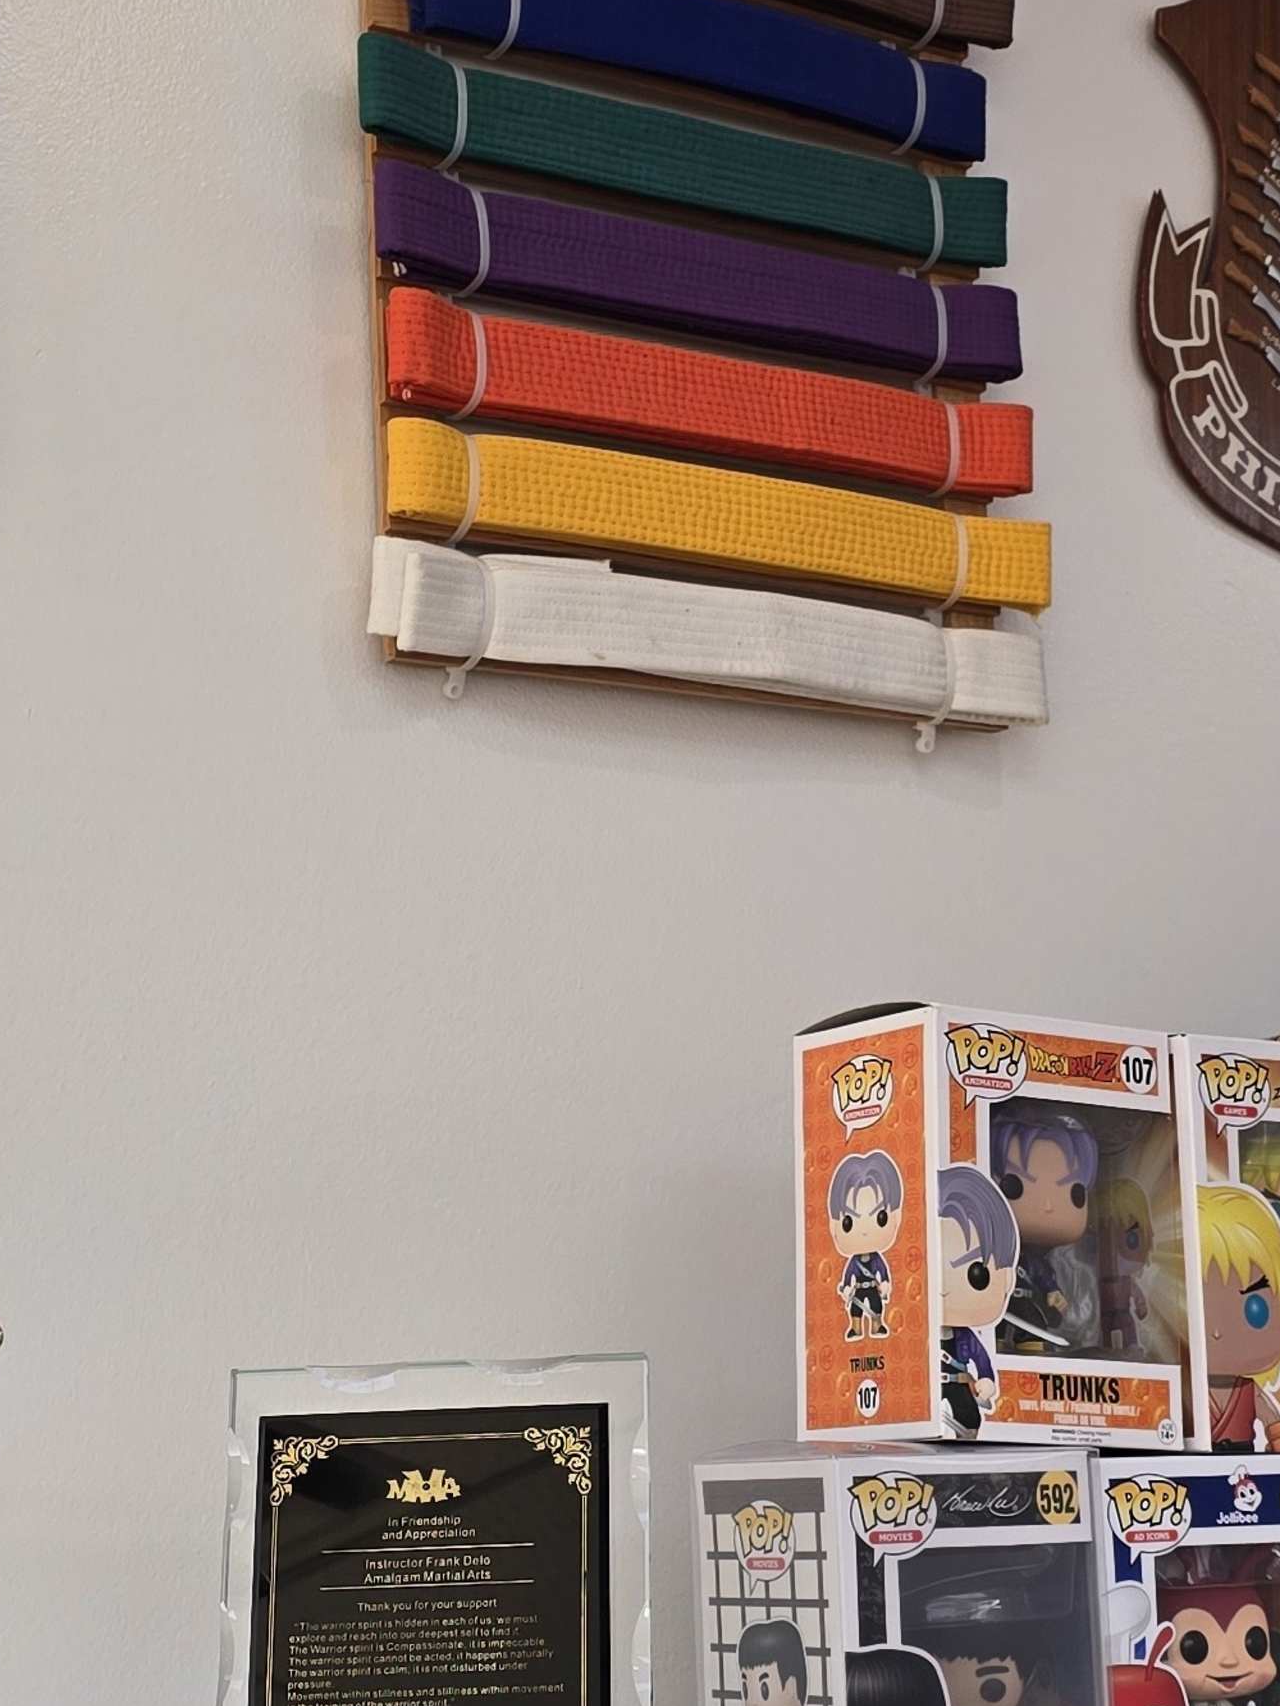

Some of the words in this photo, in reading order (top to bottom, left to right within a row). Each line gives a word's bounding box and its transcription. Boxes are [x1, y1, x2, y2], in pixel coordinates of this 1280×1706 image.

[944, 1025, 1027, 1077] POP!
[1122, 1056, 1154, 1086] 107
[831, 1059, 892, 1111] POP!
[964, 1075, 1012, 1090] ANIMATION
[1197, 1057, 1269, 1104] POP!
[850, 1355, 885, 1373] TRUNKS
[1039, 1373, 1121, 1404] TRUNKS
[858, 1387, 878, 1409] 107
[847, 1477, 935, 1532] POP!
[1039, 1483, 1075, 1514] 592
[1105, 1479, 1187, 1532] POP!
[387, 1516, 399, 1527] In
[401, 1515, 461, 1527] Friendship
[1216, 1511, 1259, 1525] Jollibee
[382, 1529, 402, 1541] and
[404, 1527, 476, 1541] Appreciation
[731, 1504, 793, 1558] POP!
[878, 1531, 914, 1542] MOVIES
[1134, 1533, 1145, 1542] AD
[1146, 1532, 1170, 1542] ICONS
[365, 1558, 423, 1570] Instructor
[425, 1555, 460, 1568] Frank
[463, 1554, 491, 1566] Delo
[364, 1572, 421, 1585] Amalgam
[423, 1570, 465, 1582] Martial
[467, 1569, 491, 1580] Arts
[357, 1601, 390, 1612] Thank
[392, 1602, 412, 1613] you
[414, 1600, 429, 1611] for
[431, 1600, 454, 1612] your
[456, 1598, 497, 1610] support
[358, 1620, 382, 1631] spirit
[395, 1618, 428, 1629] hidden
[442, 1616, 466, 1627] each
[513, 1614, 538, 1624] must
[289, 1634, 326, 1644] explore
[349, 1631, 377, 1642] reach
[418, 1627, 458, 1640] deepest
[310, 1643, 347, 1654] Warrior
[349, 1643, 374, 1654] spirit
[309, 1656, 345, 1666] warrior
[347, 1655, 372, 1666] spirit
[373, 1653, 408, 1664] cannot
[465, 1651, 508, 1662] happens
[309, 1667, 345, 1677] warrior
[346, 1666, 371, 1677] spirit
[450, 1662, 497, 1673] disturbed
[498, 1660, 528, 1671] under
[287, 1690, 340, 1701] Movement
[341, 1689, 371, 1700] within
[373, 1688, 414, 1699] stillness
[437, 1686, 478, 1697] stillness
[480, 1685, 510, 1695] within
[511, 1683, 564, 1695] movement
